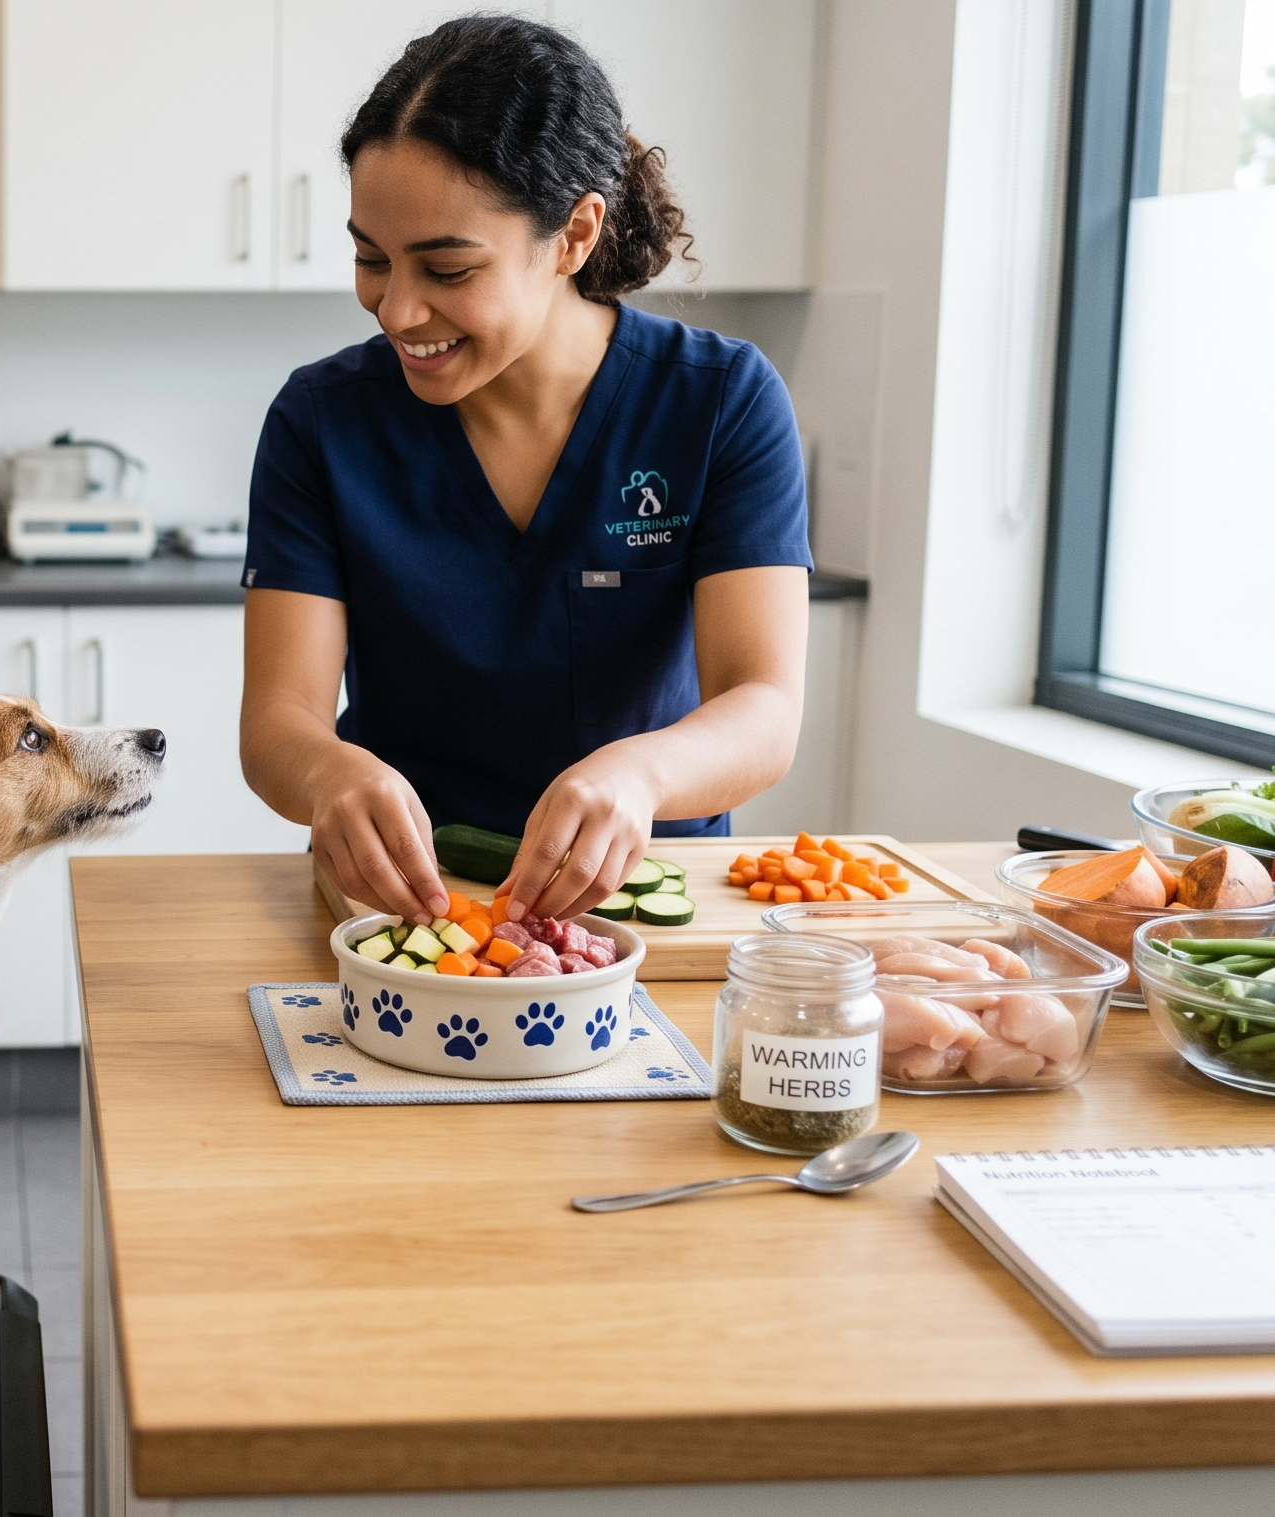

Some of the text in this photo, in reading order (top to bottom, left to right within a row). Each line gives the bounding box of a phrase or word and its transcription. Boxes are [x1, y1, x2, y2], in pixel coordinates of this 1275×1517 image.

[604, 514, 690, 535] VETERINARY
[626, 531, 672, 547] CLINIC
[751, 1043, 867, 1070] WARMING
[768, 1076, 851, 1098] HERBS
[982, 1169, 1067, 1181] Nutrition
